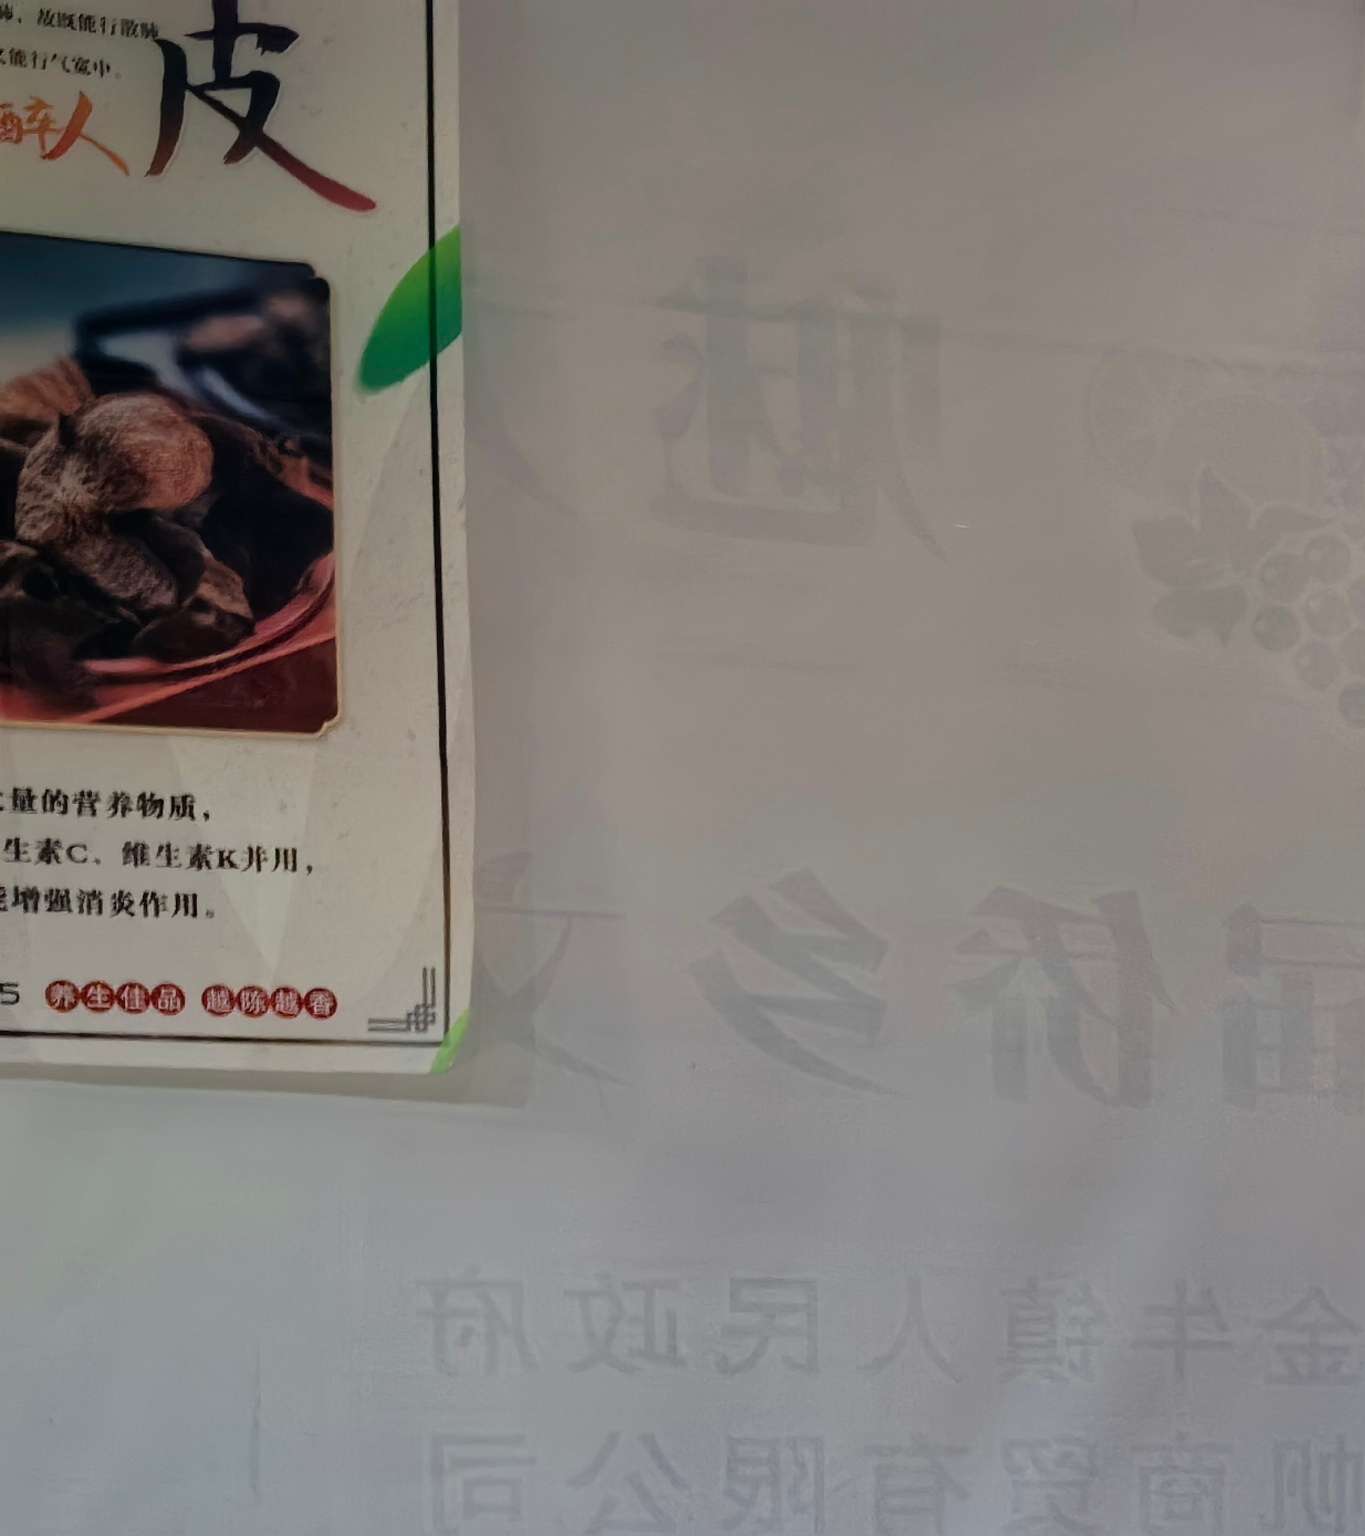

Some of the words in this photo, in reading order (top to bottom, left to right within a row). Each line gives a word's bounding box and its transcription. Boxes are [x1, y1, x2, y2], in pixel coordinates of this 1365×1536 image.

[145, 0, 377, 212] 皮
[0, 787, 210, 822] 量的营养物质，
[0, 884, 215, 919] 增强消炎作用。
